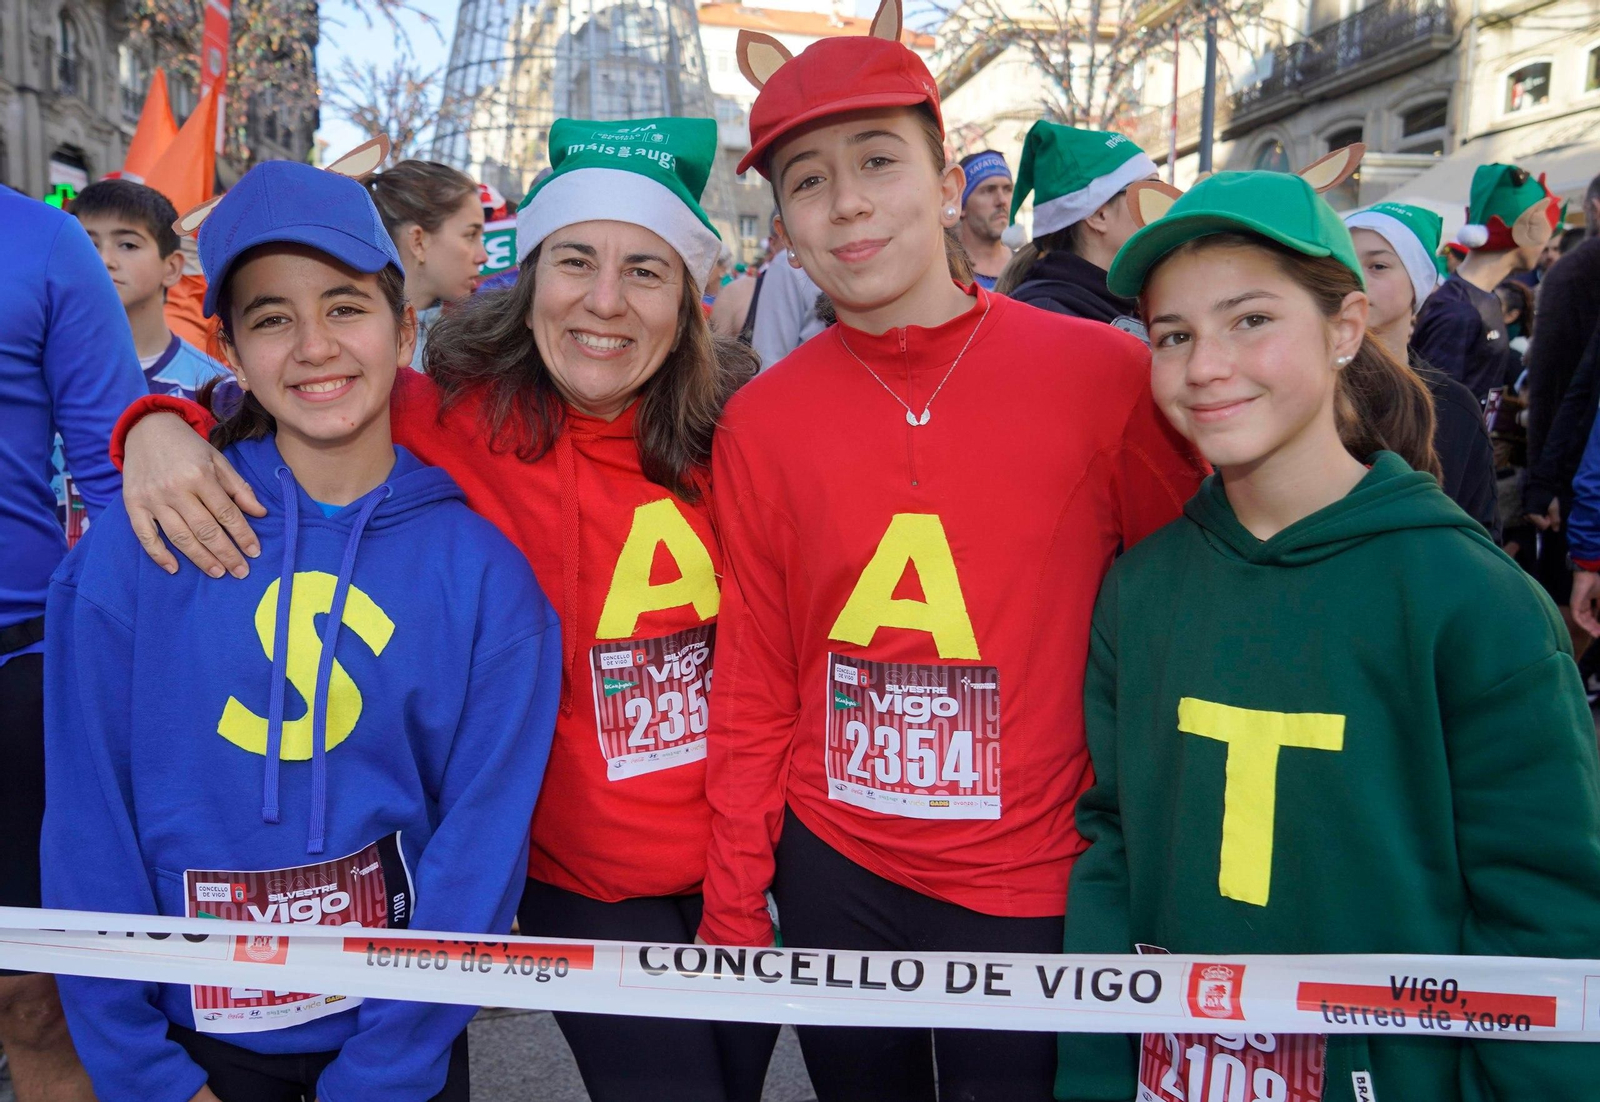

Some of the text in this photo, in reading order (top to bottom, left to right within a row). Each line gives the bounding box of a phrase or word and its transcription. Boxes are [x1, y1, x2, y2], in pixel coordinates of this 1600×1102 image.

[596, 498, 722, 639] A
[828, 513, 981, 660] A
[217, 570, 396, 761] S
[602, 653, 631, 662] CONCELLO
[646, 647, 710, 683] vigo
[836, 666, 857, 676] CONCELLO
[885, 683, 948, 695] SILVESTRE
[869, 690, 960, 724] vigo
[845, 720, 980, 789] 2354
[1177, 696, 1347, 908] T
[199, 885, 229, 893] CONCELLO
[267, 882, 338, 902] SILVESTRE
[393, 892, 406, 922] 2109
[365, 941, 449, 971] terreo
[460, 947, 493, 973] de
[503, 952, 570, 983] xogo
[638, 946, 1163, 1004] CONCELLO DE VIGO
[1390, 975, 1467, 1010] VIGO,
[1319, 1000, 1406, 1028] terreo
[1418, 1003, 1452, 1031] de
